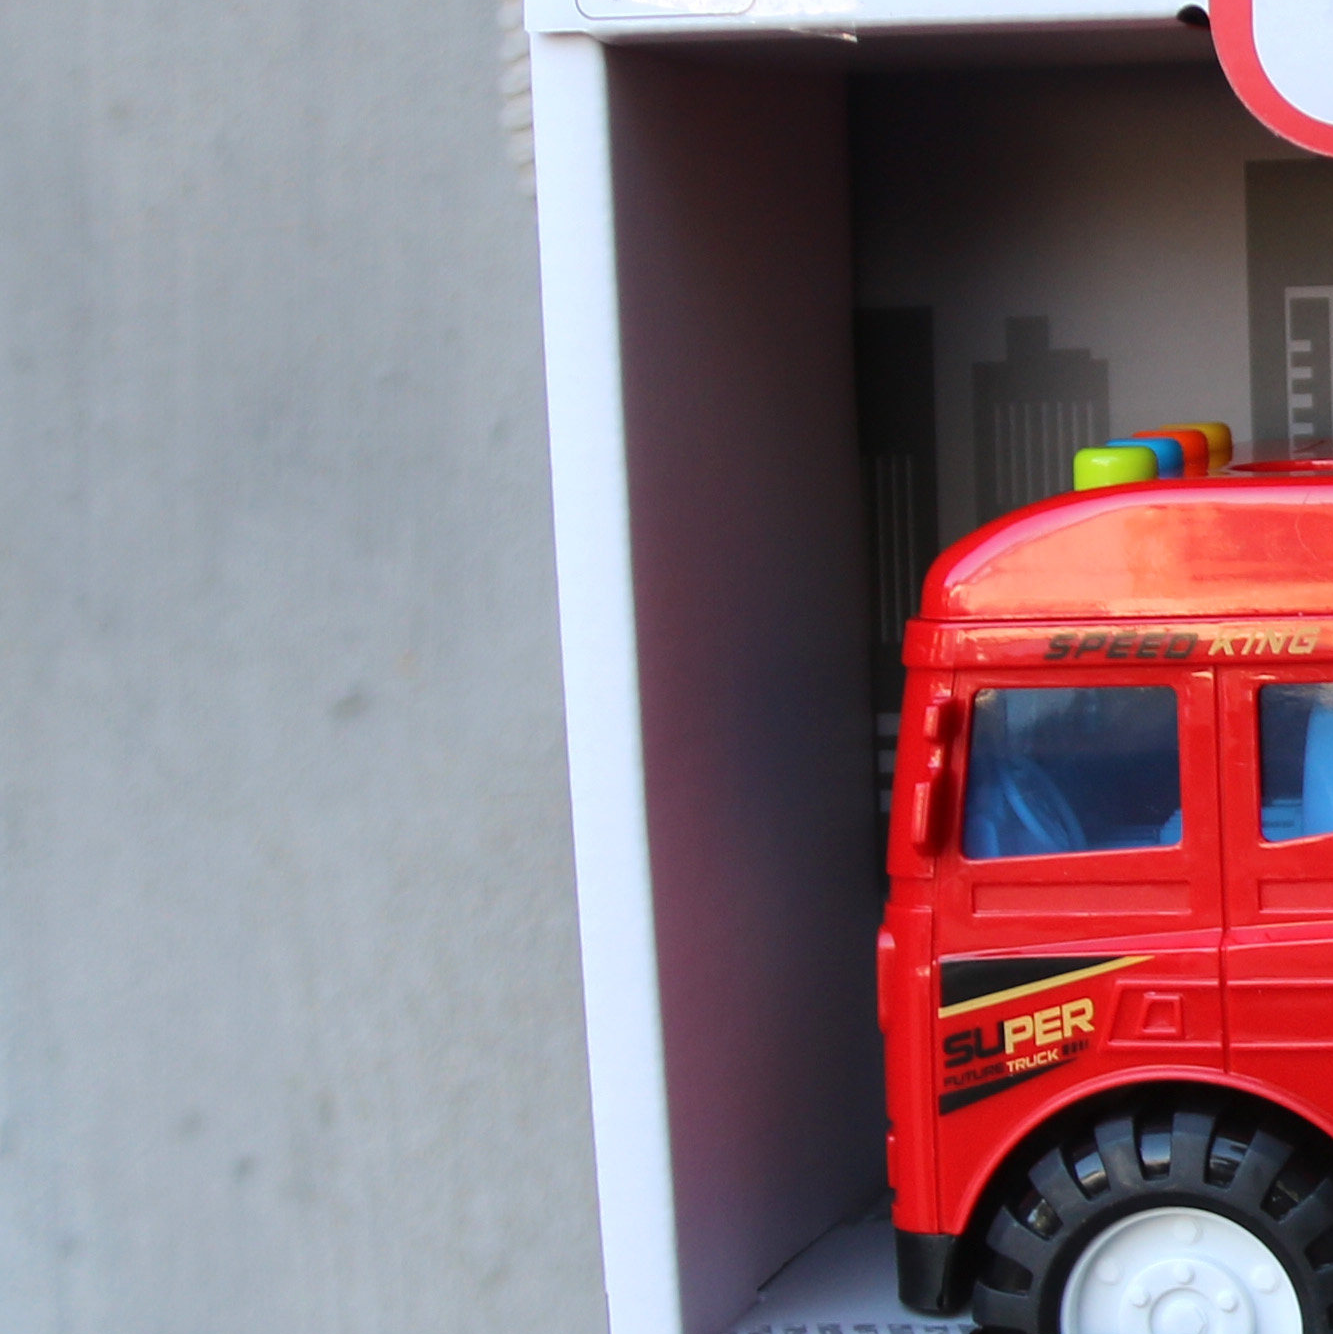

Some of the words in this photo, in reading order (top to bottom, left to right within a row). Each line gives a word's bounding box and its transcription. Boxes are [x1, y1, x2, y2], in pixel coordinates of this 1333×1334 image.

[1044, 632, 1198, 659] SPEED
[1208, 627, 1321, 655] KING
[944, 998, 1094, 1068] SUPER
[1006, 1048, 1059, 1073] TRUCK
